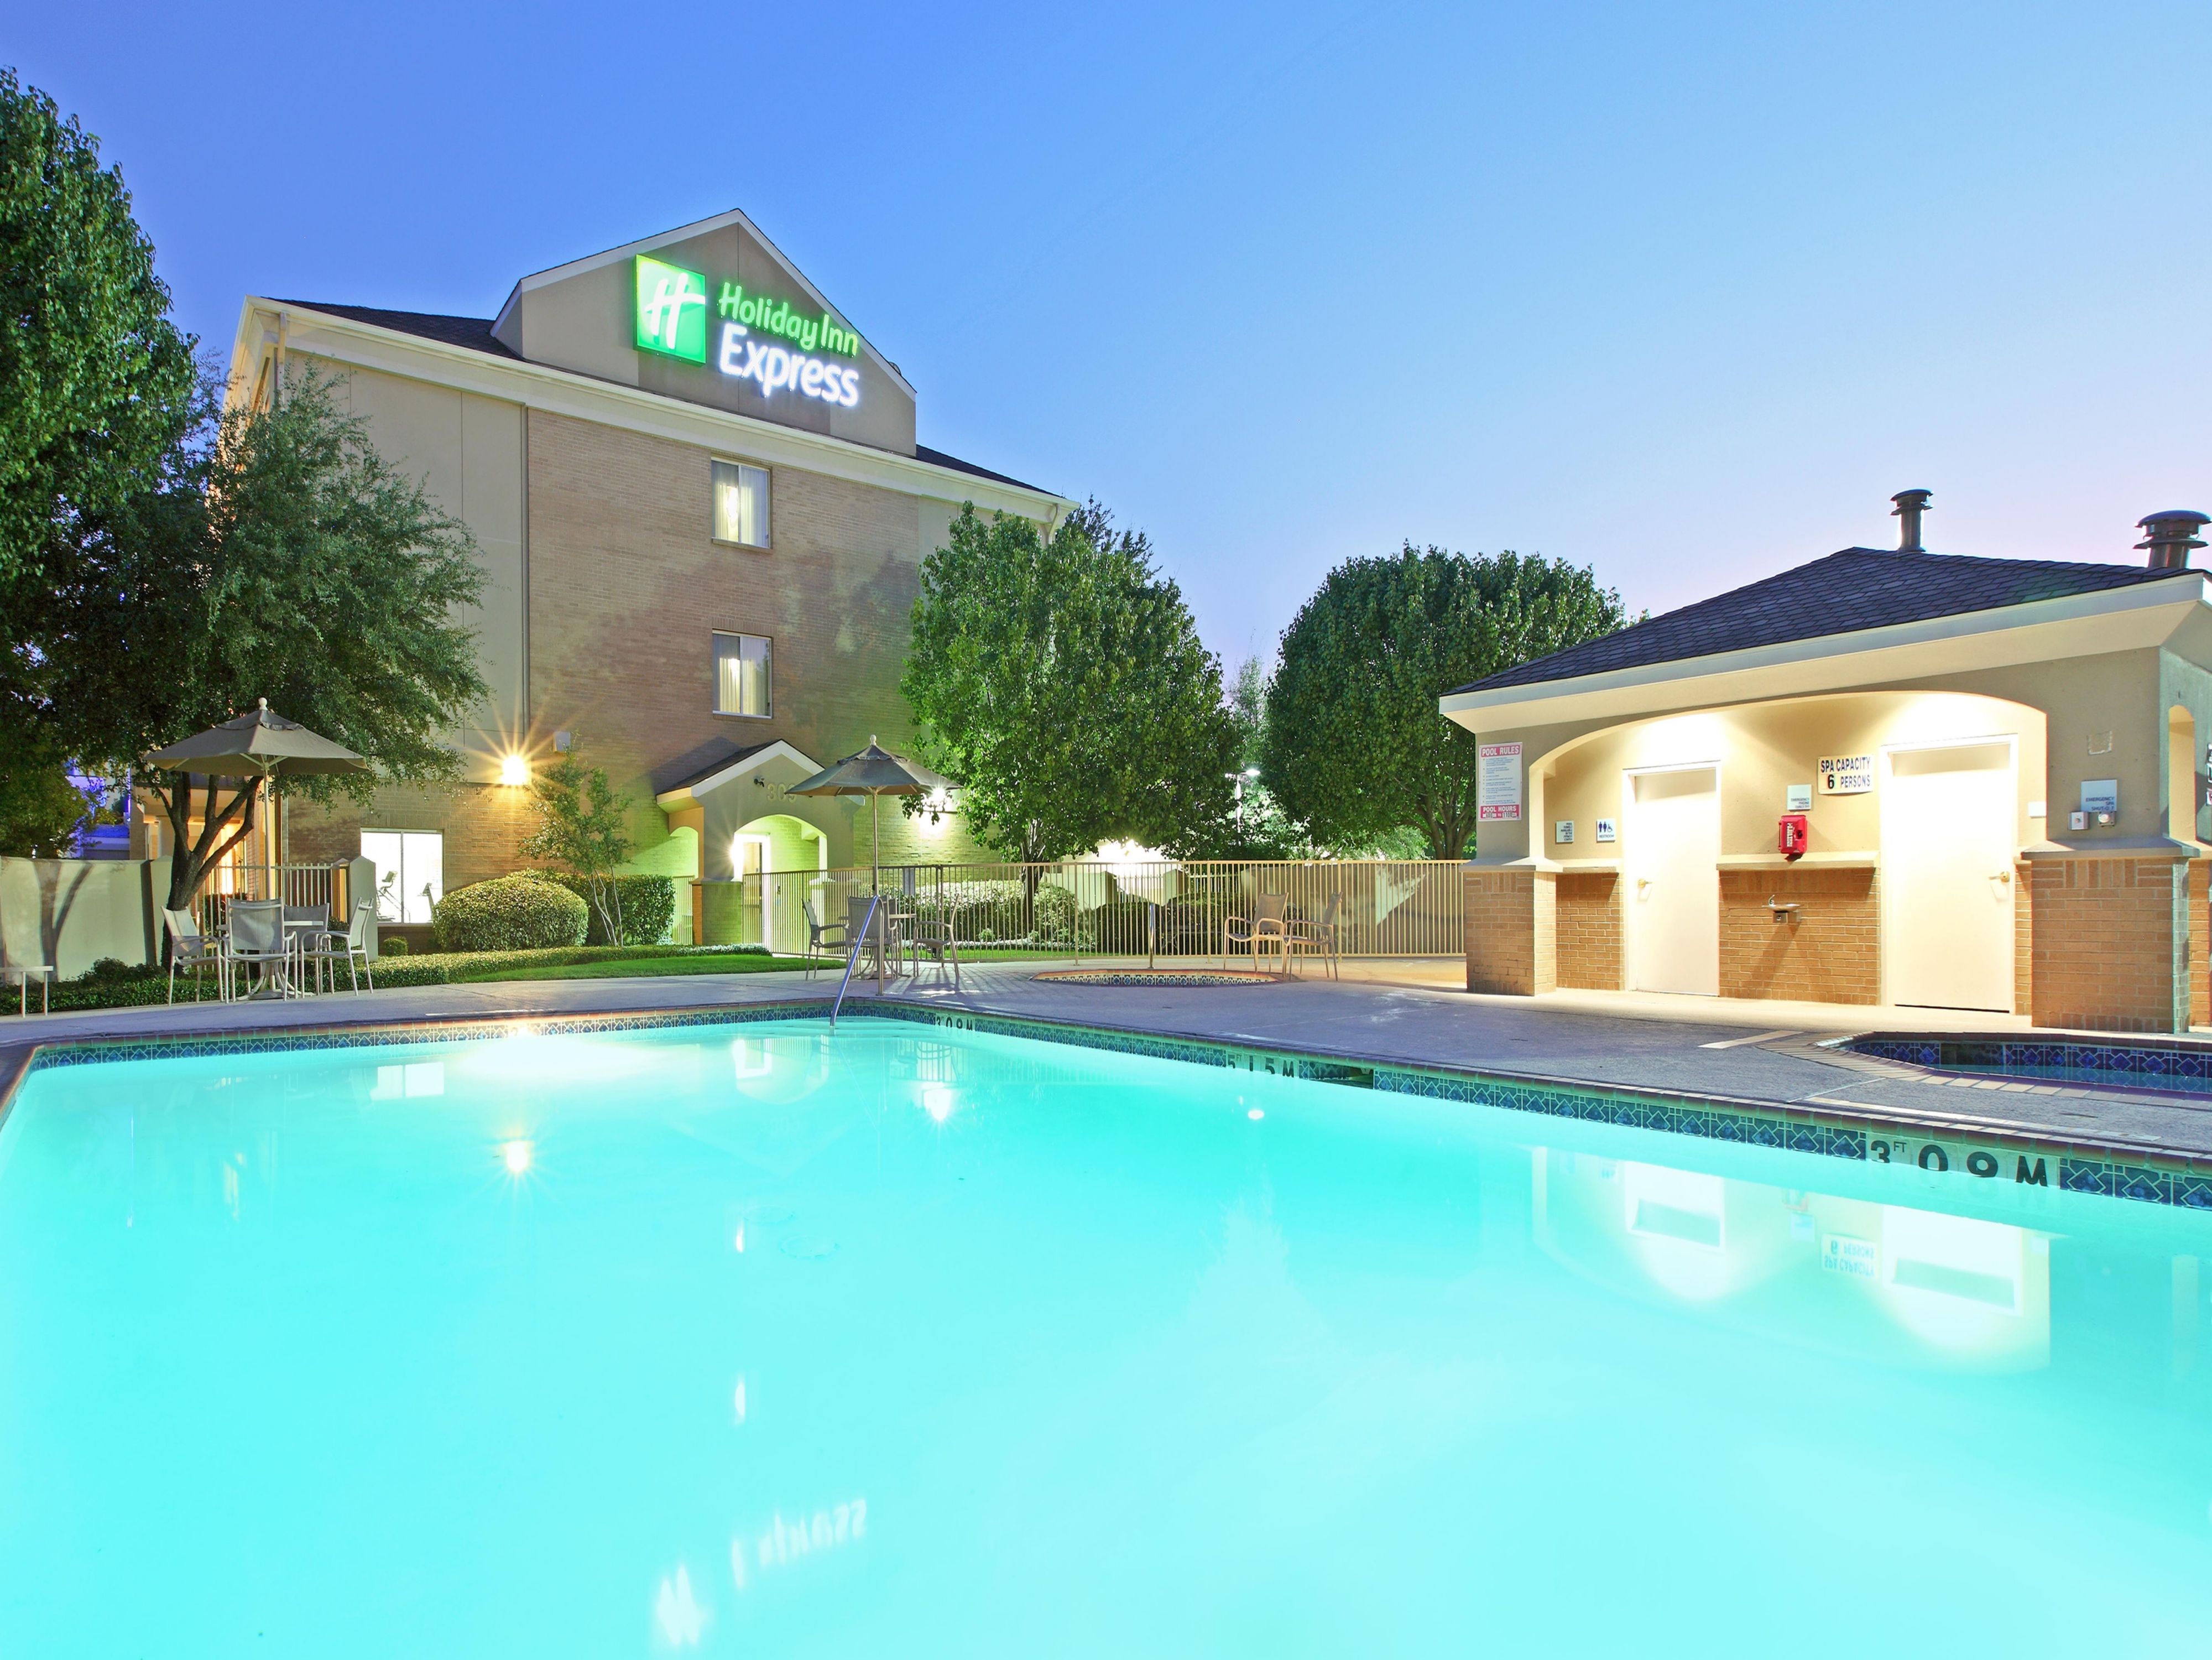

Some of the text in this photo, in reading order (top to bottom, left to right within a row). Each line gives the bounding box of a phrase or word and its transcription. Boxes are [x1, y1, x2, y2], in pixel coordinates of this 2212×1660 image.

[719, 282, 858, 357] Holiday Inn
[719, 322, 860, 407] Express
[1482, 746, 1519, 756] POOL RULES
[1821, 757, 1870, 773] SPA CAPACITY
[1828, 774, 1870, 789] 6 PERSONS
